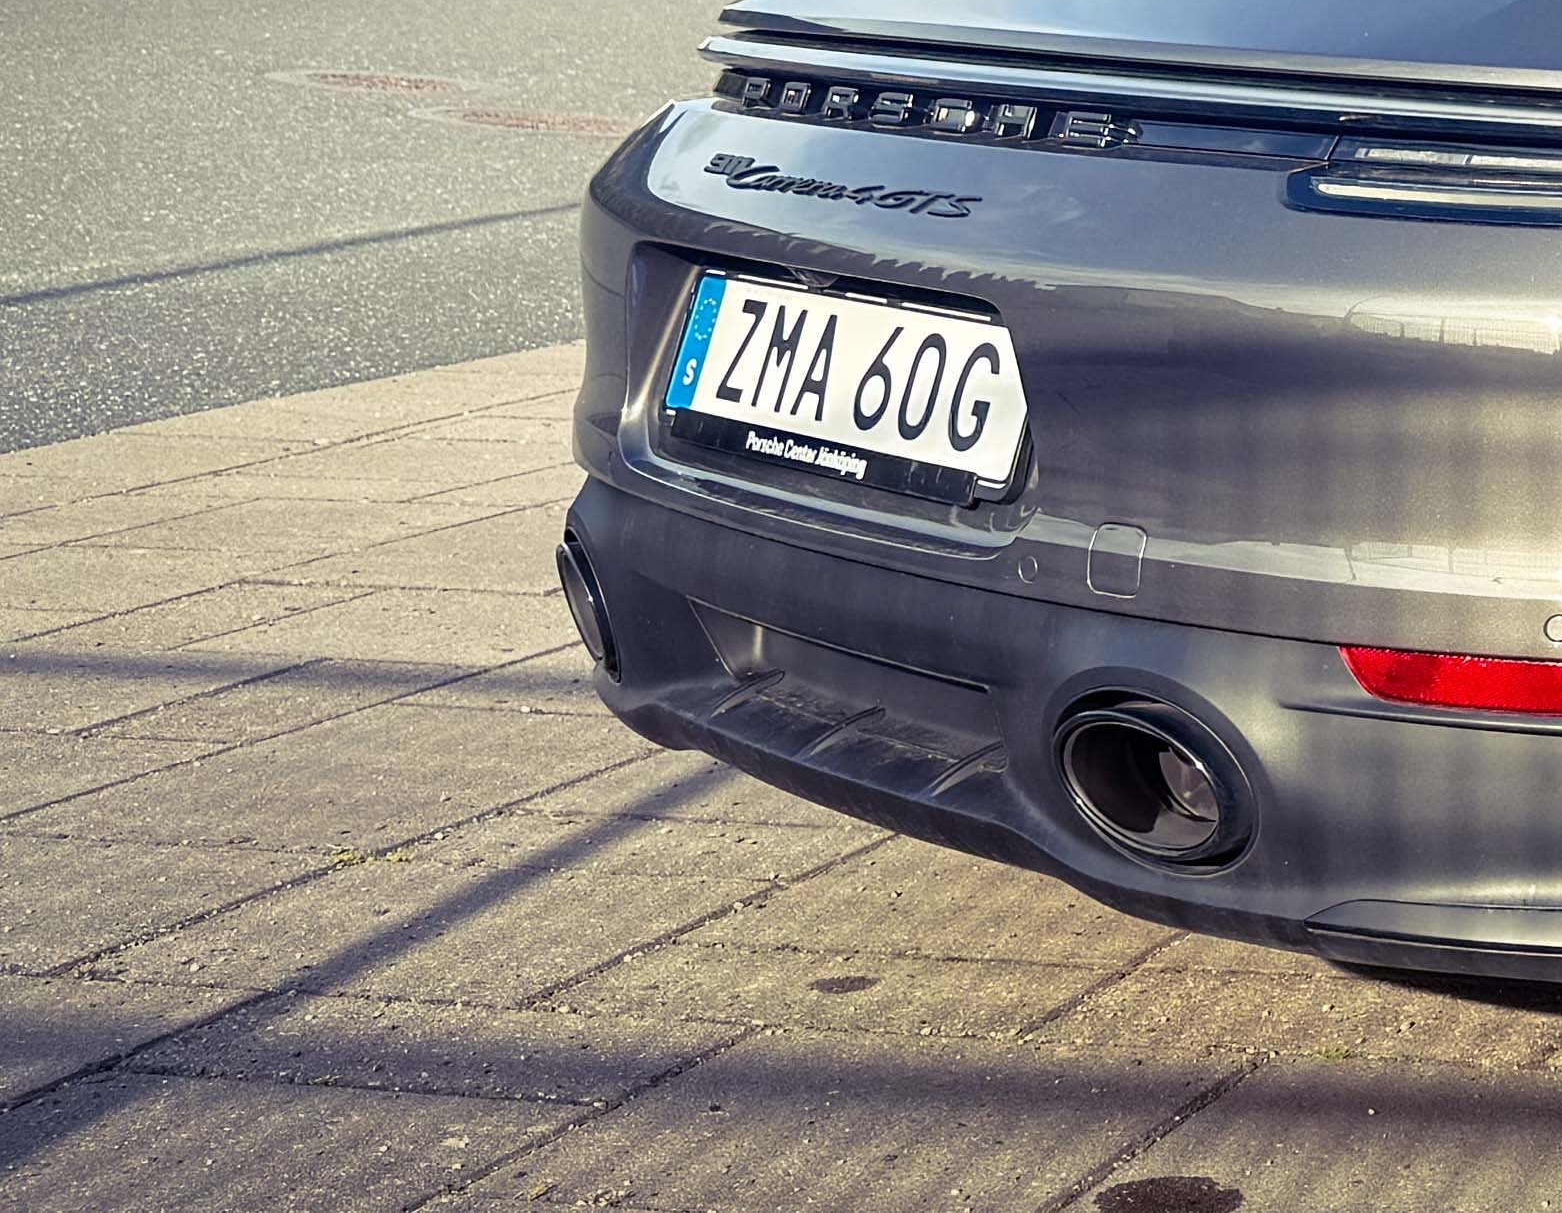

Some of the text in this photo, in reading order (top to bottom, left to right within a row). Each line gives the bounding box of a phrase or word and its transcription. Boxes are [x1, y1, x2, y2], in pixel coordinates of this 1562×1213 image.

[739, 76, 1112, 149] PORSCHE
[873, 189, 984, 218] GTS
[682, 358, 696, 386] S
[715, 298, 1000, 452] ZMA 60G
[745, 430, 784, 457] Porsche
